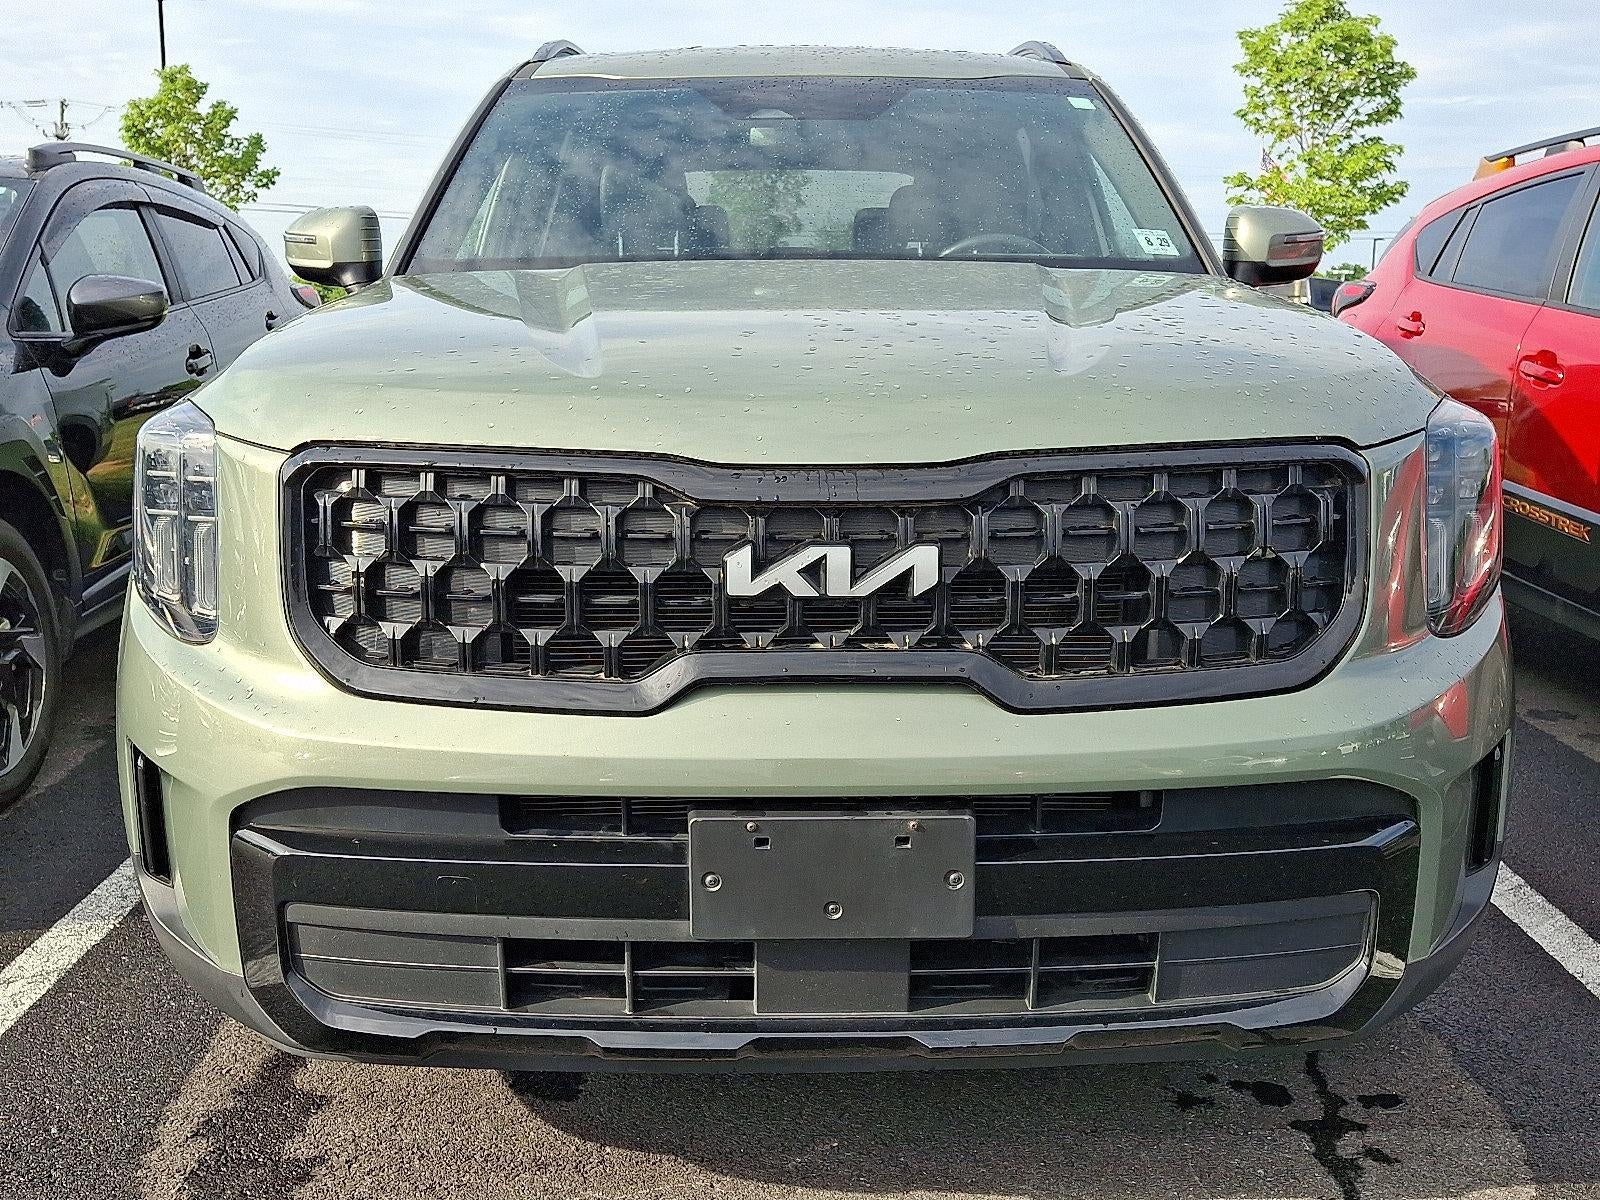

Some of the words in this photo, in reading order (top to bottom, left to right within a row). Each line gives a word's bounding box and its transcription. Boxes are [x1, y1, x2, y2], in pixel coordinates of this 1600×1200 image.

[1144, 236, 1154, 247] 8
[1502, 494, 1592, 542] CROSSTREK
[724, 544, 939, 597] KIA
